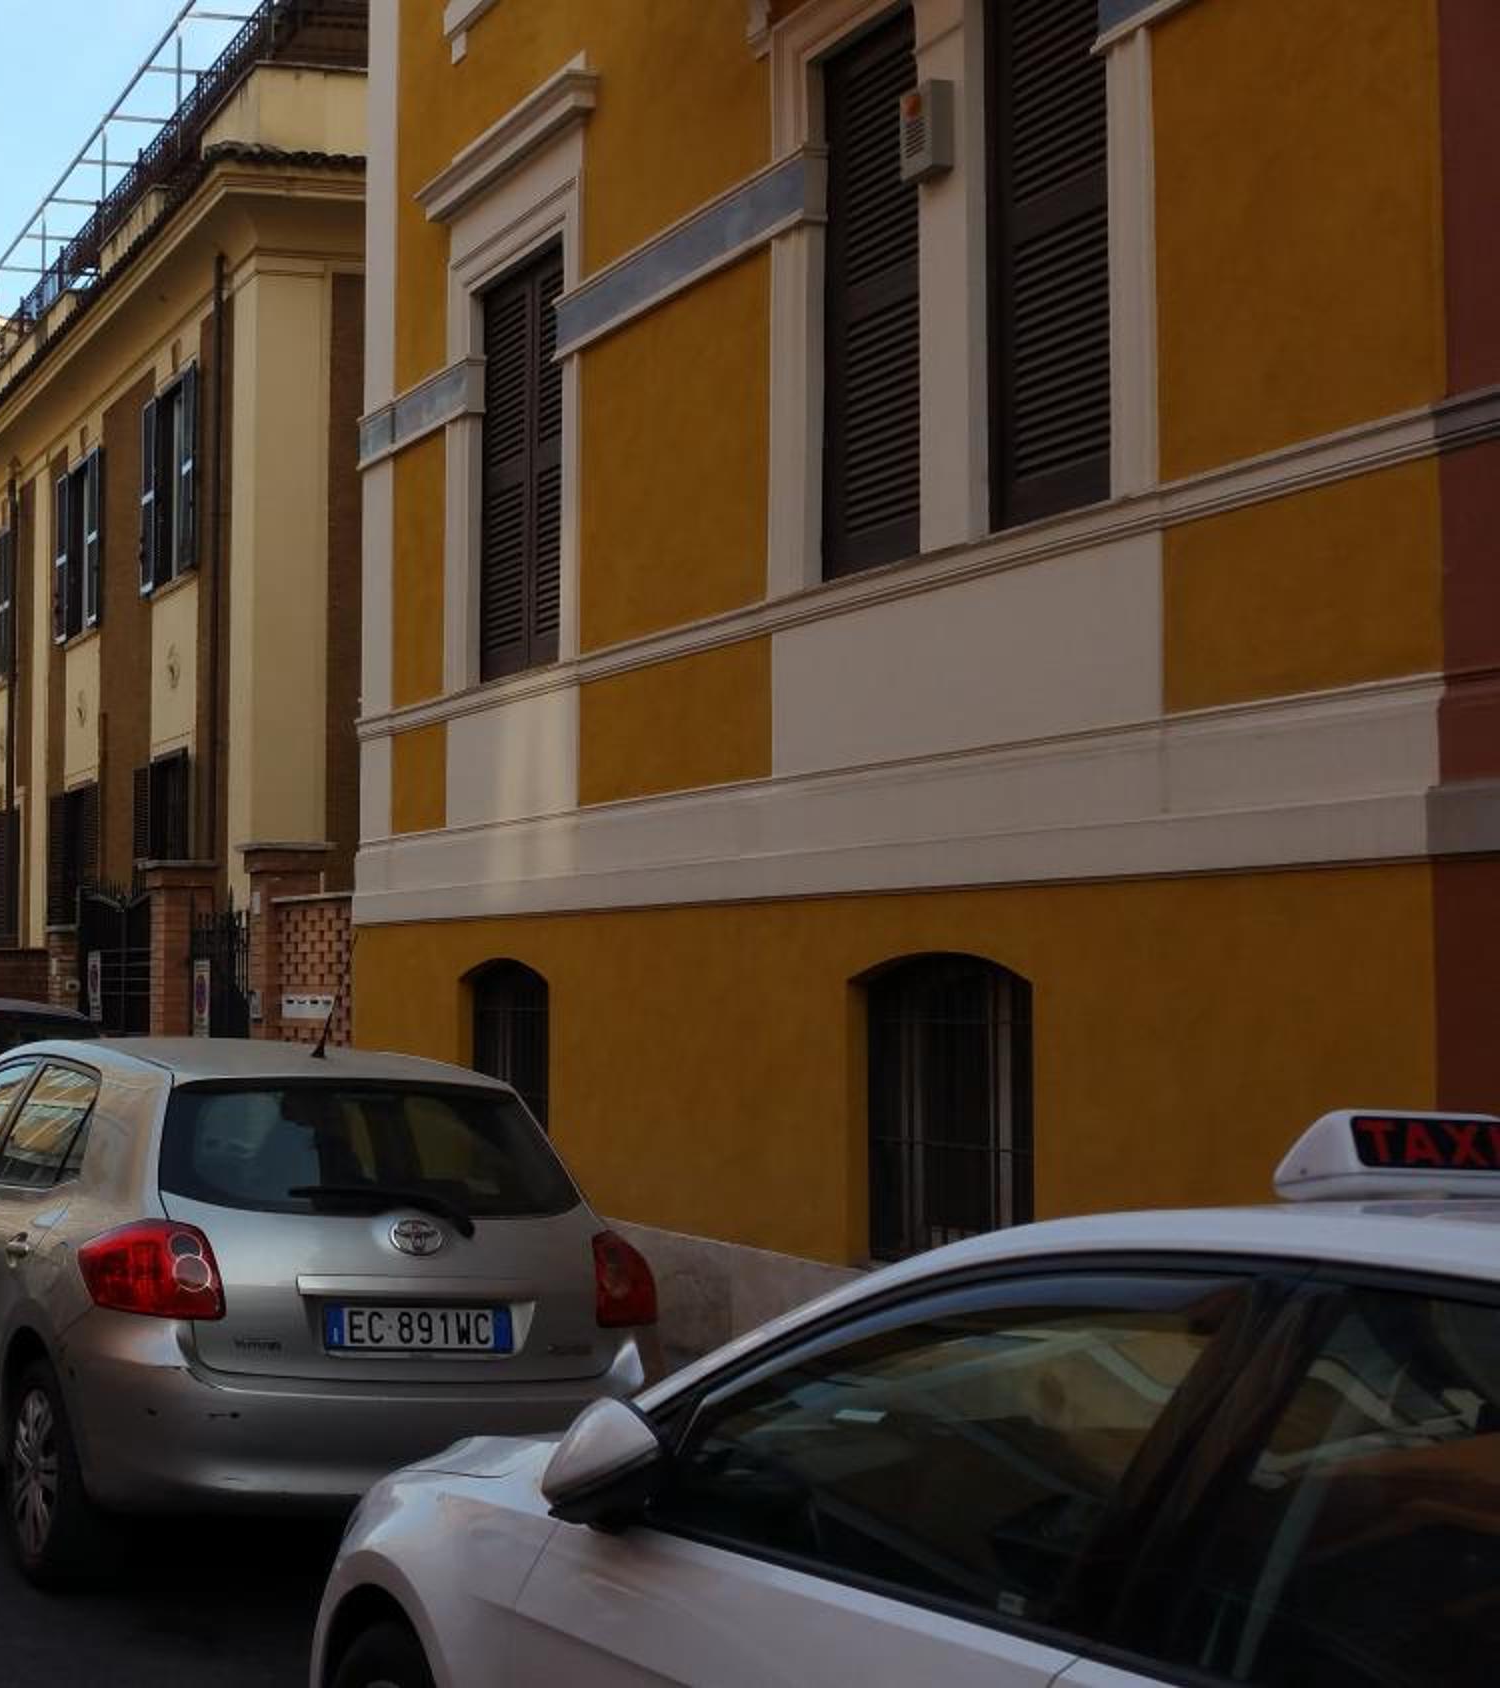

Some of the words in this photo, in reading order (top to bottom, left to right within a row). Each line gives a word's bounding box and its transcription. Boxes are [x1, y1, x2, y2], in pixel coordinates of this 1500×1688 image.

[1357, 1119, 1500, 1167] TAXI
[348, 1310, 385, 1344] EC
[397, 1310, 491, 1345] 891WC
